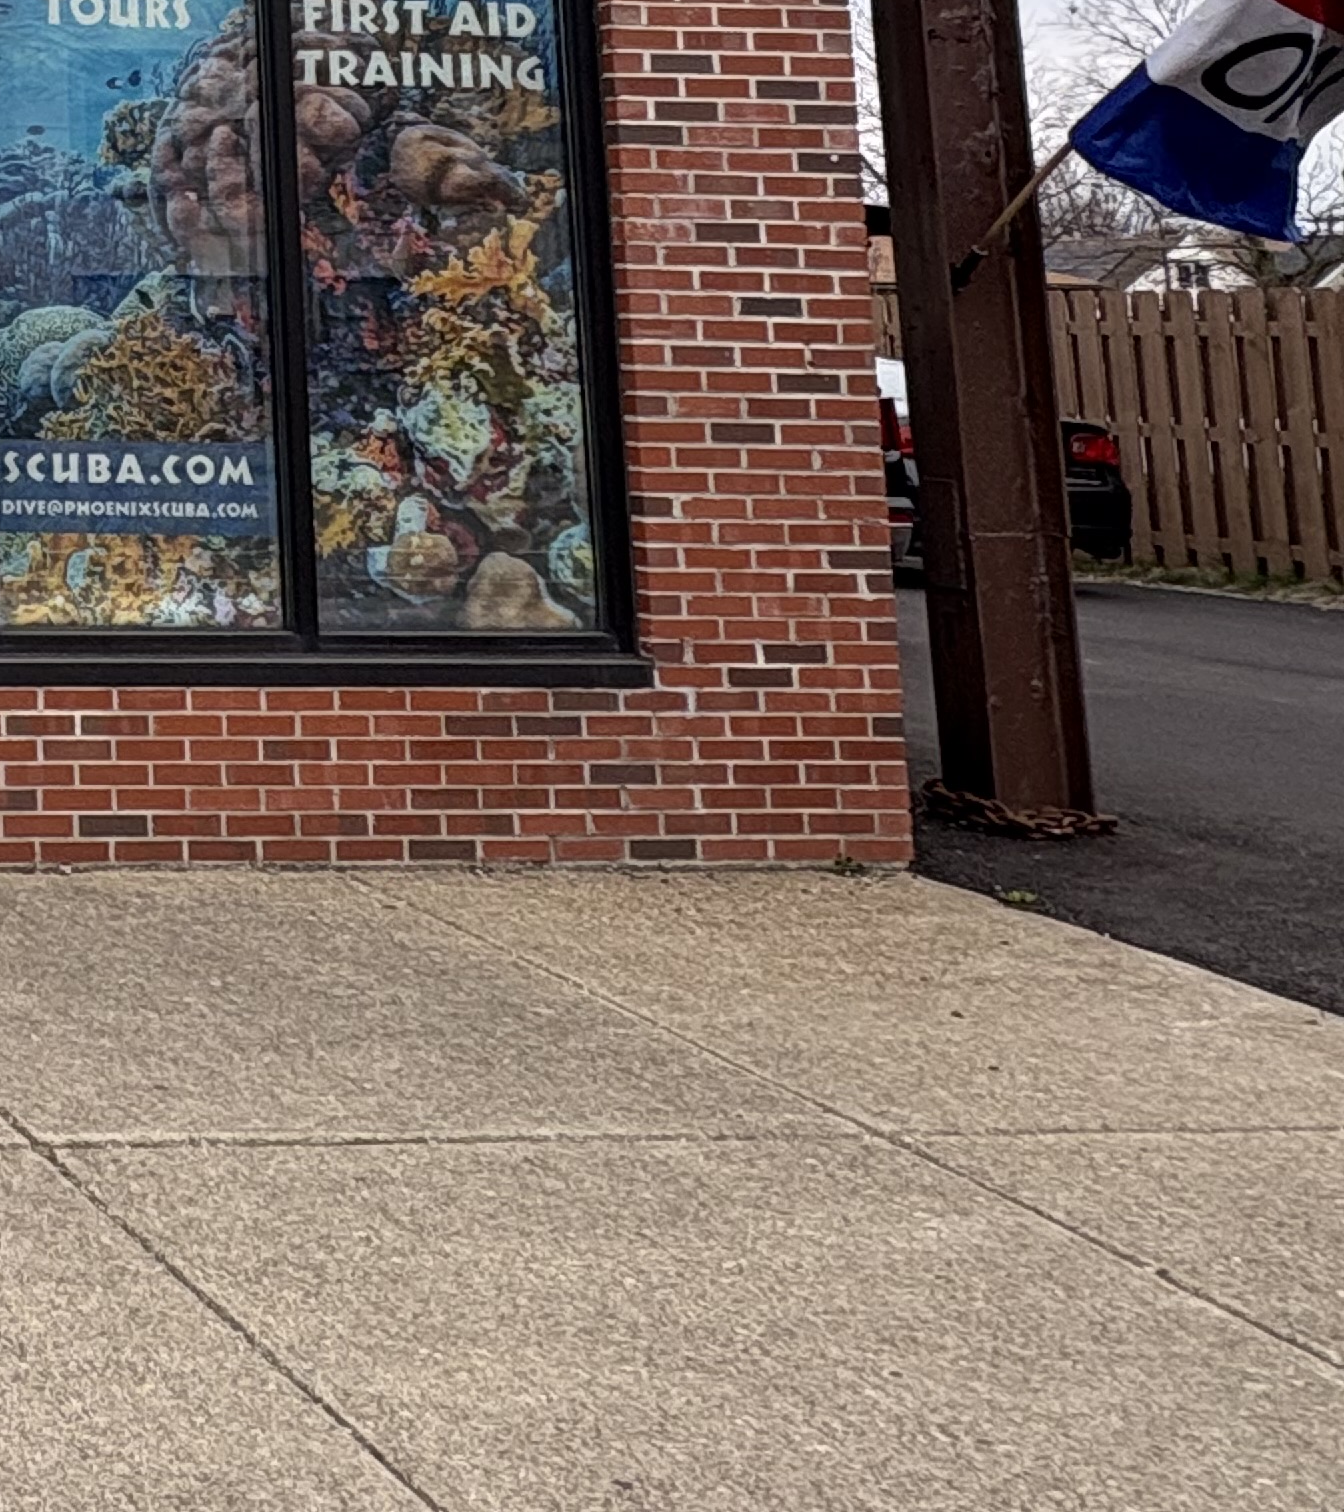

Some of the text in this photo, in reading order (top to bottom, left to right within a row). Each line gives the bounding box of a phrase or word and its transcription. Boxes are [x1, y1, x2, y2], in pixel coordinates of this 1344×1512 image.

[448, 1, 537, 38] AID
[296, 49, 545, 90] TRAINING
[4, 450, 255, 486] SCUBA.COM
[1, 499, 260, 519] DIVE@PHOENIXSCUBA.COM
